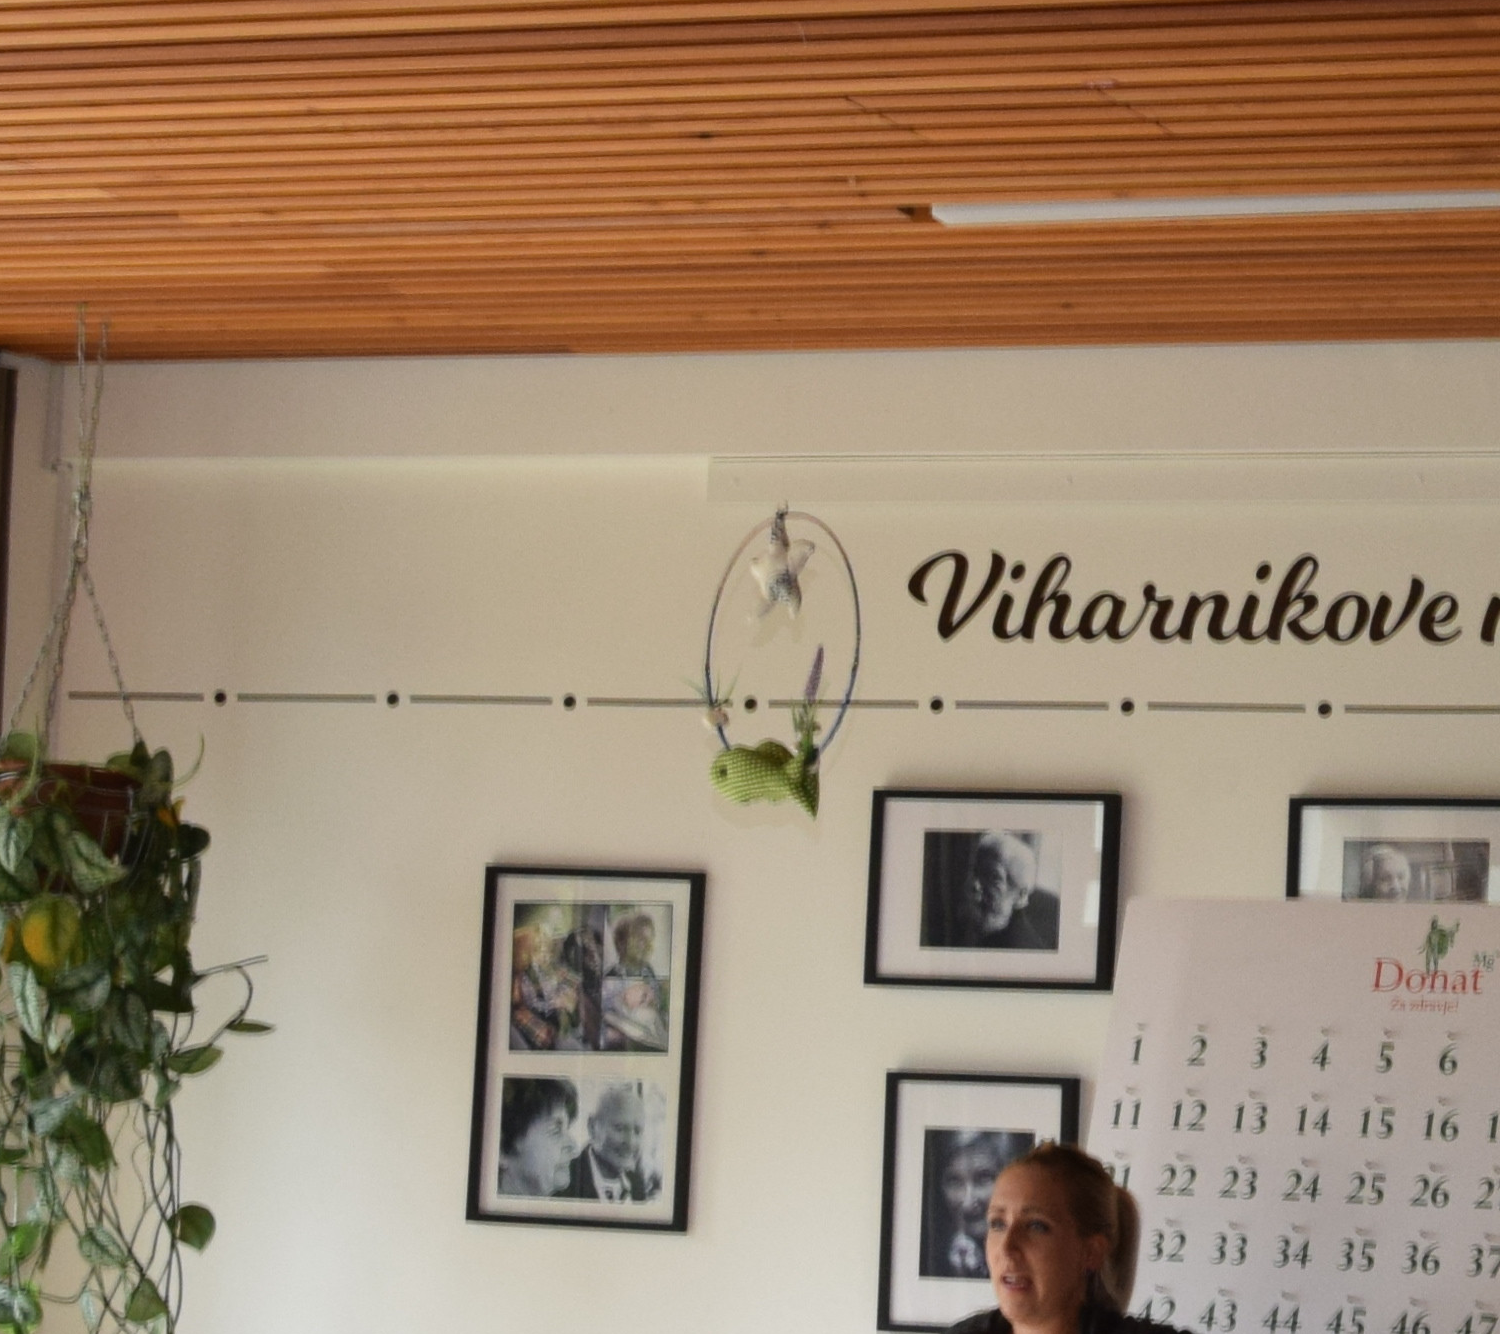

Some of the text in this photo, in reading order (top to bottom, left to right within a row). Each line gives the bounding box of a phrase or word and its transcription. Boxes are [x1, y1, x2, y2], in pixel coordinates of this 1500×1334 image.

[908, 548, 1461, 644] Viharnikove
[1371, 957, 1484, 995] Donat
[1131, 1035, 1144, 1066] 1
[1186, 1034, 1209, 1068] 2
[1248, 1036, 1269, 1070] 3
[1311, 1041, 1332, 1072] 4
[1376, 1040, 1396, 1075] 5
[1437, 1047, 1459, 1077] 6
[1110, 1098, 1143, 1131] 11
[1171, 1098, 1209, 1133] 12
[1234, 1100, 1269, 1136] 13
[1296, 1104, 1332, 1138] 14
[1360, 1105, 1397, 1141] 15
[1423, 1110, 1461, 1143] 16
[1156, 1162, 1198, 1198] 22
[1218, 1165, 1259, 1201] 23
[1281, 1168, 1323, 1204] 24
[1344, 1170, 1388, 1207] 25
[1409, 1173, 1451, 1209] 26
[1147, 1228, 1188, 1264] 32
[1209, 1231, 1249, 1267] 33
[1272, 1234, 1313, 1271] 34
[1336, 1237, 1378, 1274] 35
[1401, 1242, 1442, 1277] 36
[1197, 1298, 1239, 1334] 43
